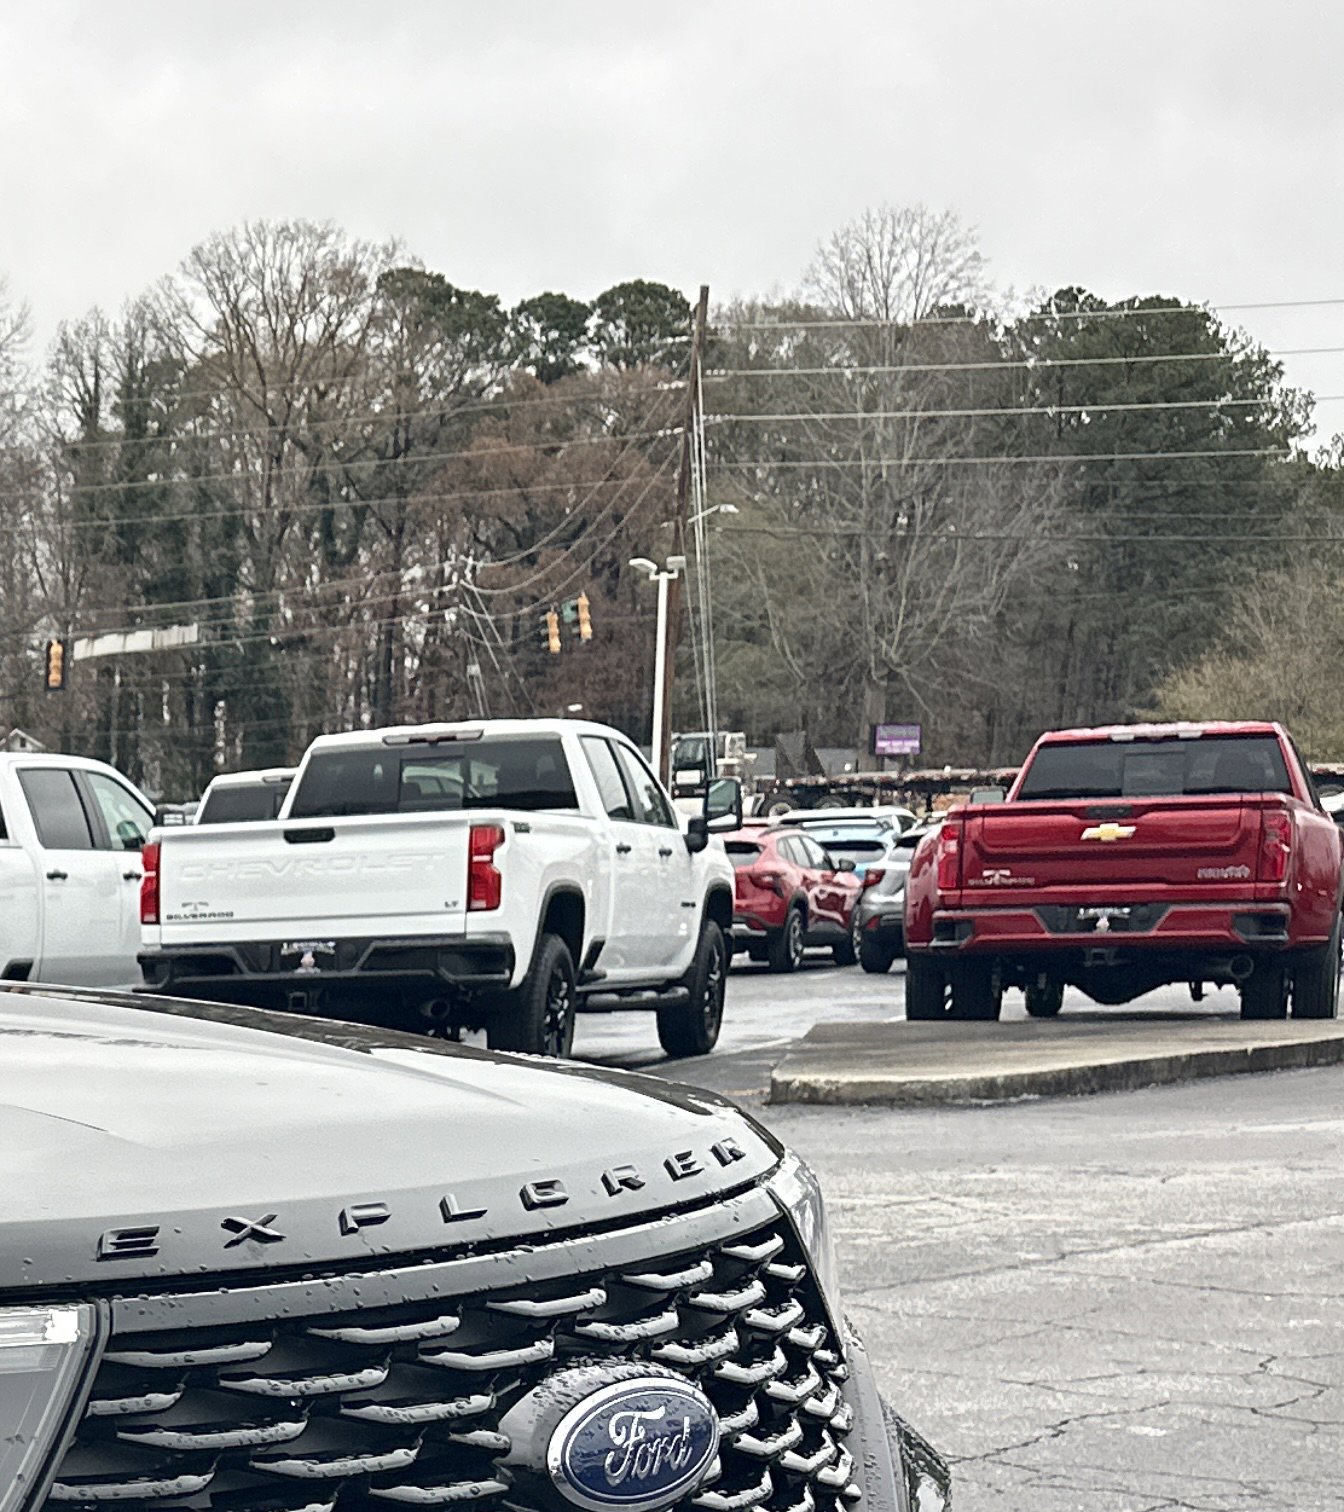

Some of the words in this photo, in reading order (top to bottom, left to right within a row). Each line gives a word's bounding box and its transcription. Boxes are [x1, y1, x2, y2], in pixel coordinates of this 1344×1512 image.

[180, 852, 446, 882] CHEVROLET
[94, 1137, 747, 1262] EXPLORER
[604, 1405, 693, 1487] Ford
